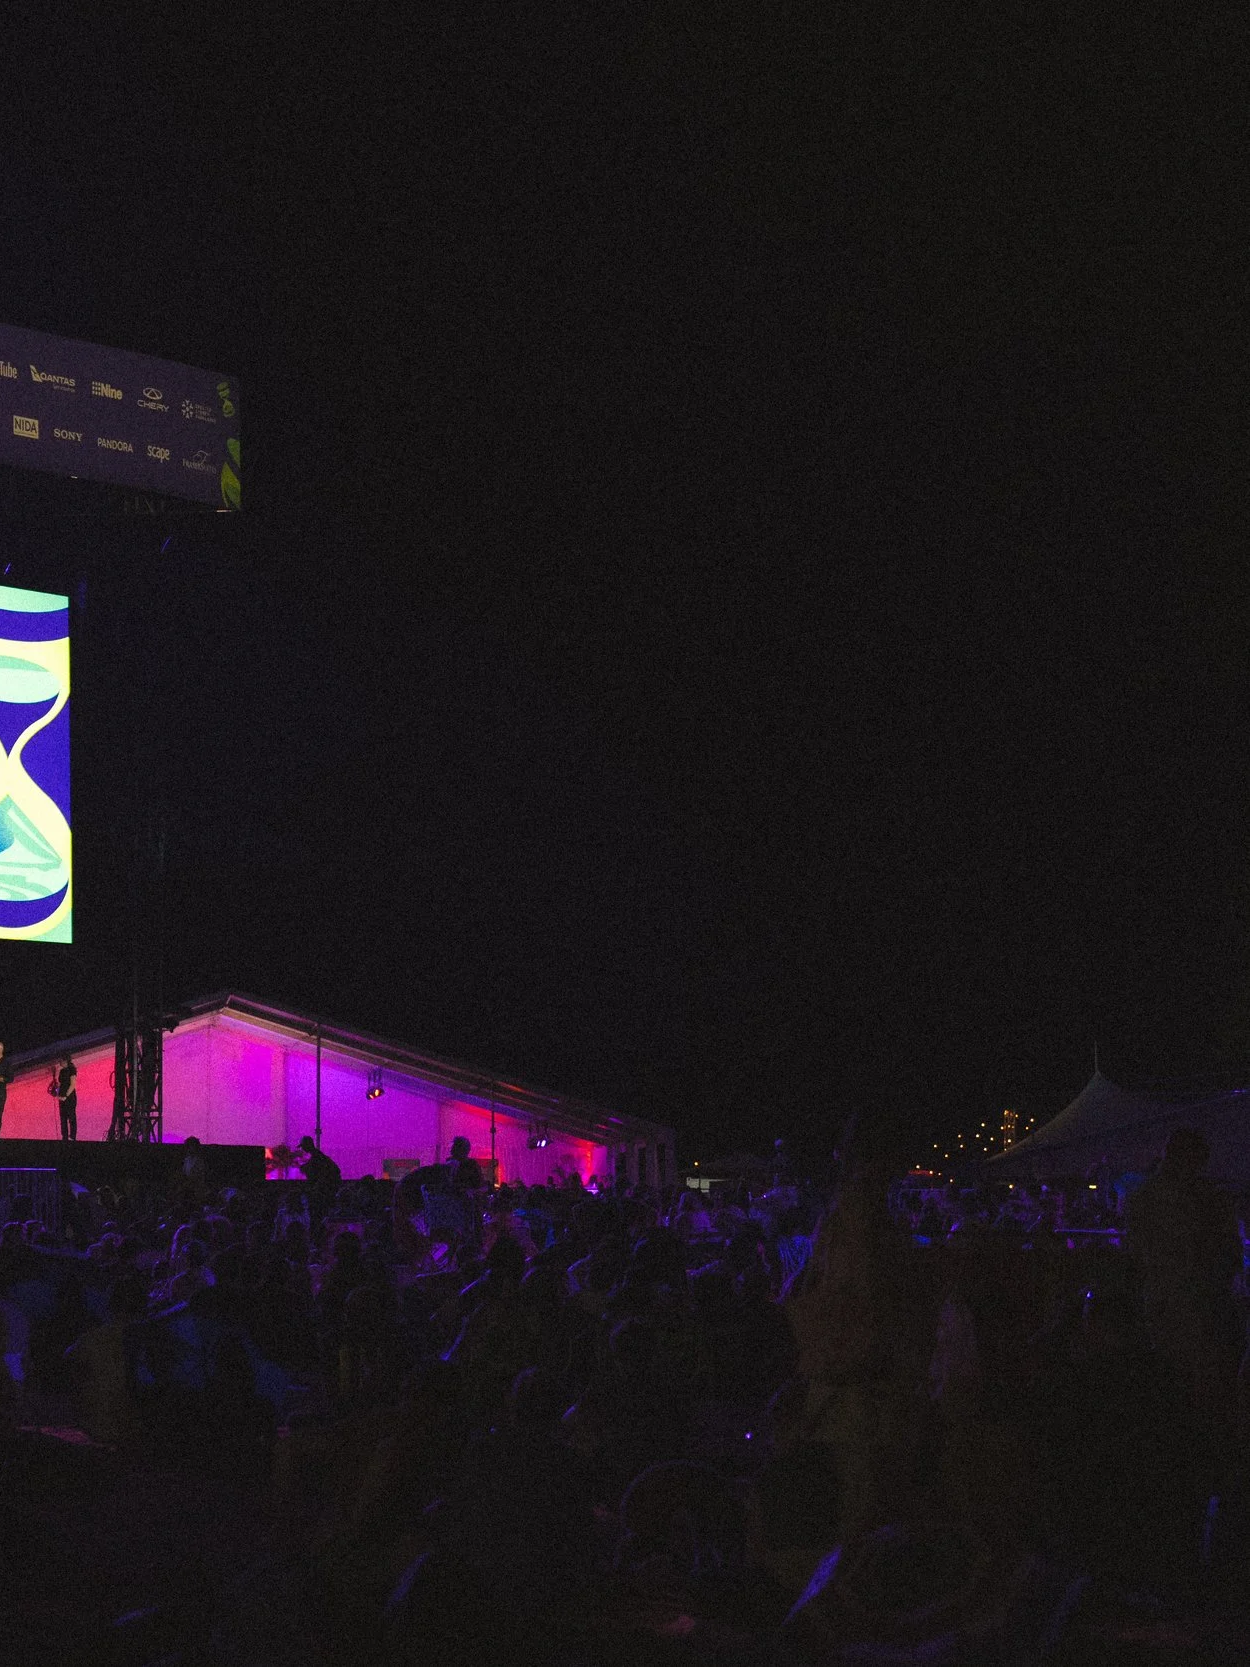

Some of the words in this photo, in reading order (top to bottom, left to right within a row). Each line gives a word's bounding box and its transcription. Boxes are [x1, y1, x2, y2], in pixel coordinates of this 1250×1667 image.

[39, 371, 76, 387] QANTAS
[100, 383, 123, 401] Nine
[136, 399, 170, 413] CHERY
[15, 416, 38, 434] NIDA
[53, 428, 83, 442] SONY
[97, 437, 133, 453] PANDORA
[147, 445, 170, 464] scape
